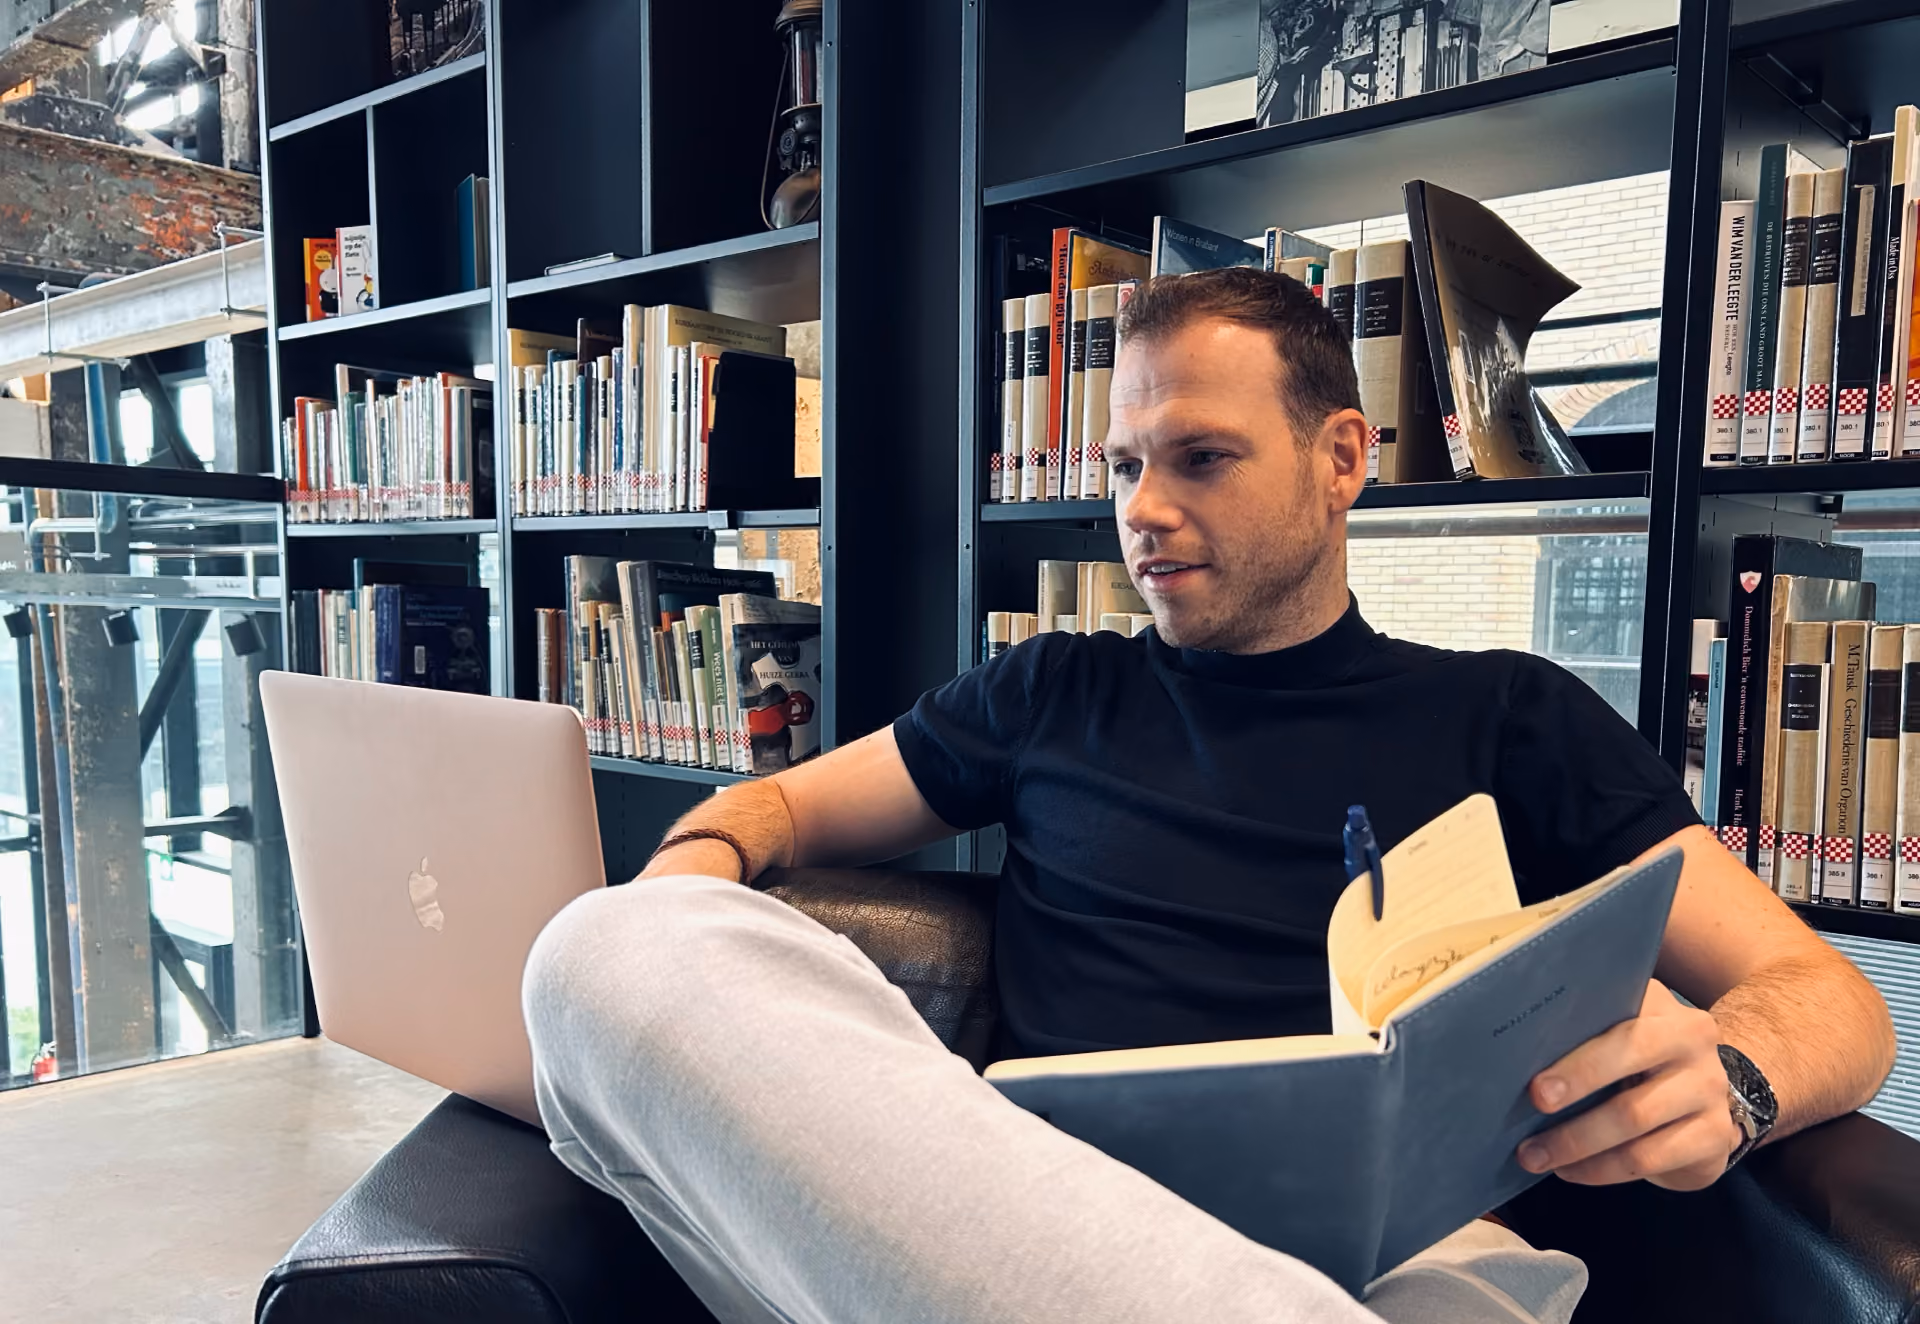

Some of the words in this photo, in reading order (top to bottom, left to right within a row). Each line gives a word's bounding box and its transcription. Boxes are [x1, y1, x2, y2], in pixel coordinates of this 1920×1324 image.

[1732, 216, 1746, 238] WIM
[1766, 221, 1774, 233] DE
[1166, 227, 1188, 244] Wonen
[1189, 236, 1195, 245] in
[1195, 238, 1219, 252] Brabant
[1730, 240, 1744, 260] VAN
[1889, 236, 1900, 256] Made
[1763, 234, 1773, 280] BEDRIJVEN
[1889, 257, 1898, 265] in
[1728, 263, 1742, 281] DER
[1887, 266, 1897, 280] Oss
[1057, 282, 1067, 300] dat
[1762, 282, 1770, 296] DIE
[1055, 303, 1065, 317] gij
[1726, 284, 1741, 321] LEEGTE
[1760, 297, 1769, 315] ONS
[1759, 316, 1767, 339] LAND
[1725, 352, 1734, 376] Leegte
[1757, 340, 1765, 369] GROOT
[1841, 423, 1858, 431] 380.1
[1742, 605, 1754, 654] Dommelsch
[713, 651, 722, 676] Wees
[1741, 656, 1751, 673] Bier
[759, 671, 783, 679] HUIZE
[1846, 660, 1860, 692] Tausk
[1738, 685, 1748, 735] eeuwenoude
[1841, 698, 1857, 766] Geschiedenis
[1736, 737, 1747, 766] traditie
[1841, 768, 1850, 786] van
[1734, 788, 1744, 811] Henk
[1732, 813, 1742, 826] Ho
[1837, 787, 1852, 834] Organon
